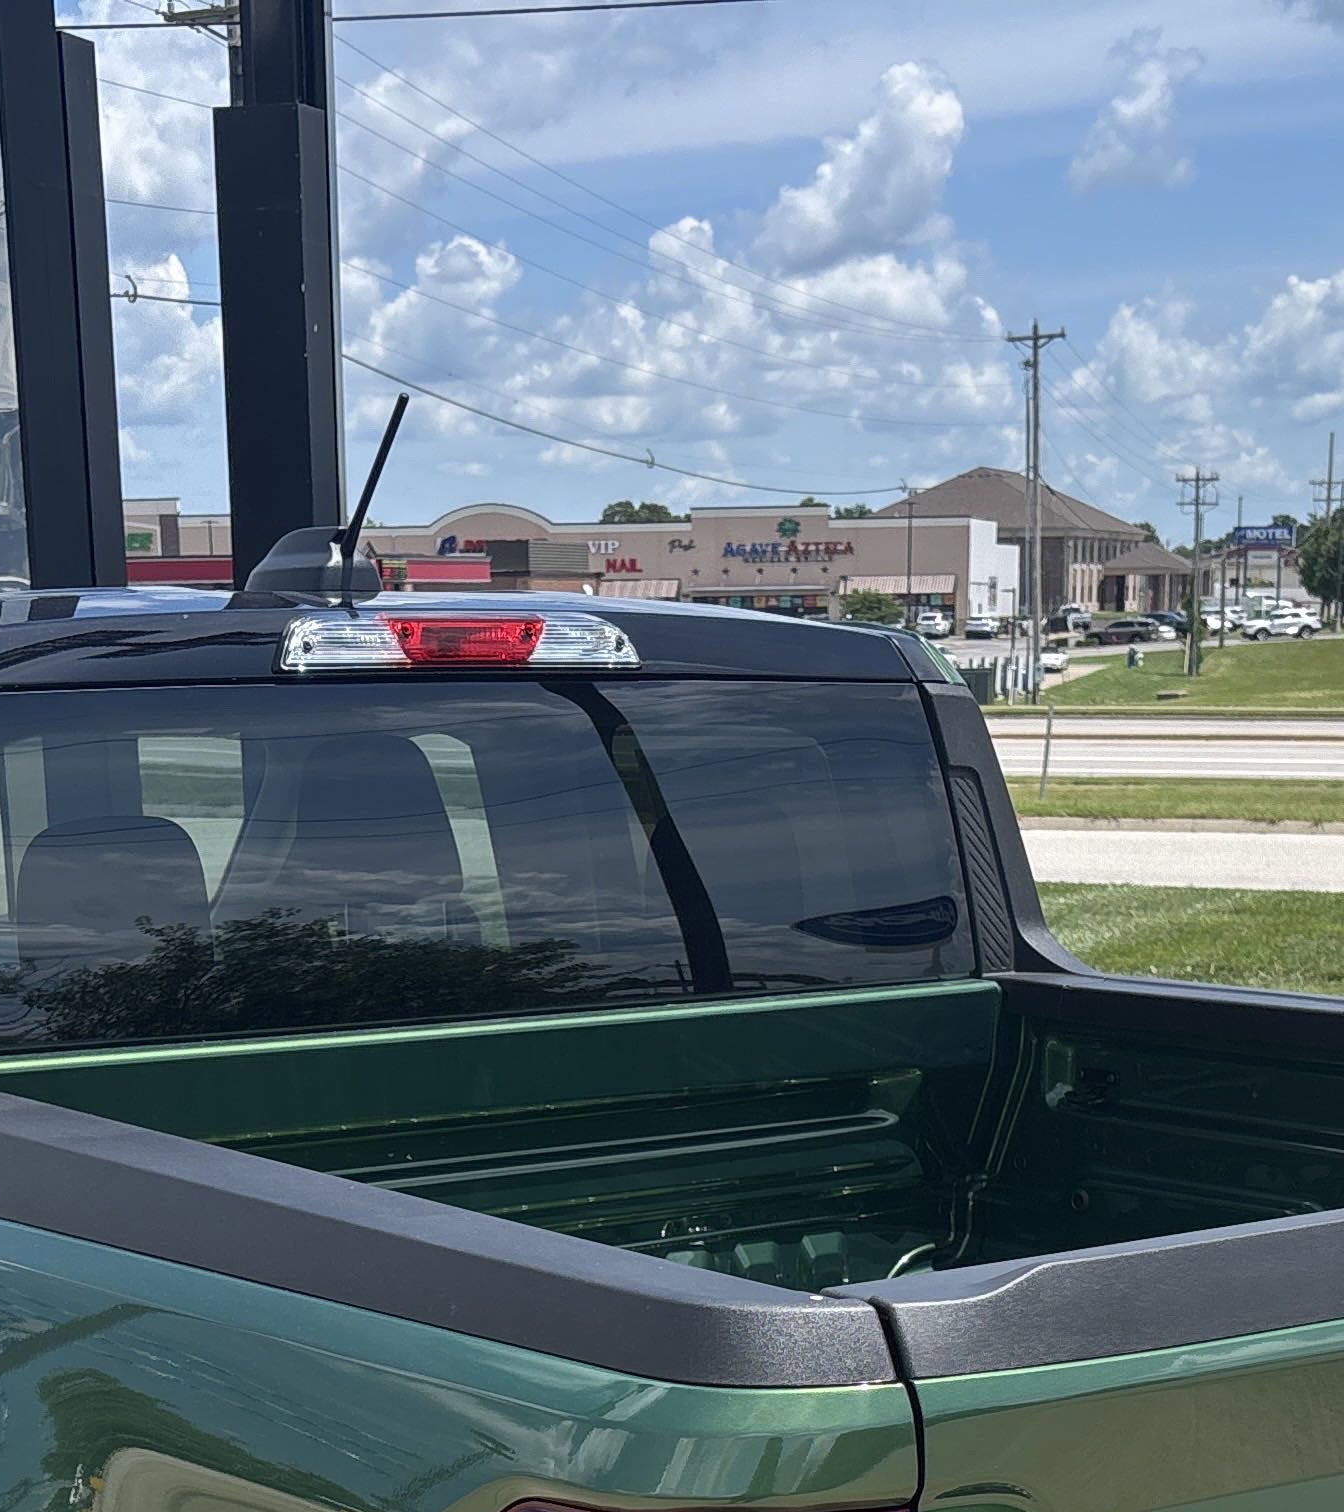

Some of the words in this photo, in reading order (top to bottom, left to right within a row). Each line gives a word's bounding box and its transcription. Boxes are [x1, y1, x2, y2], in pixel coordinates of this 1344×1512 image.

[1245, 528, 1291, 540] MOTEL
[587, 540, 620, 554] VIP
[722, 542, 782, 558] AGAVE
[785, 540, 855, 557] AZTECA
